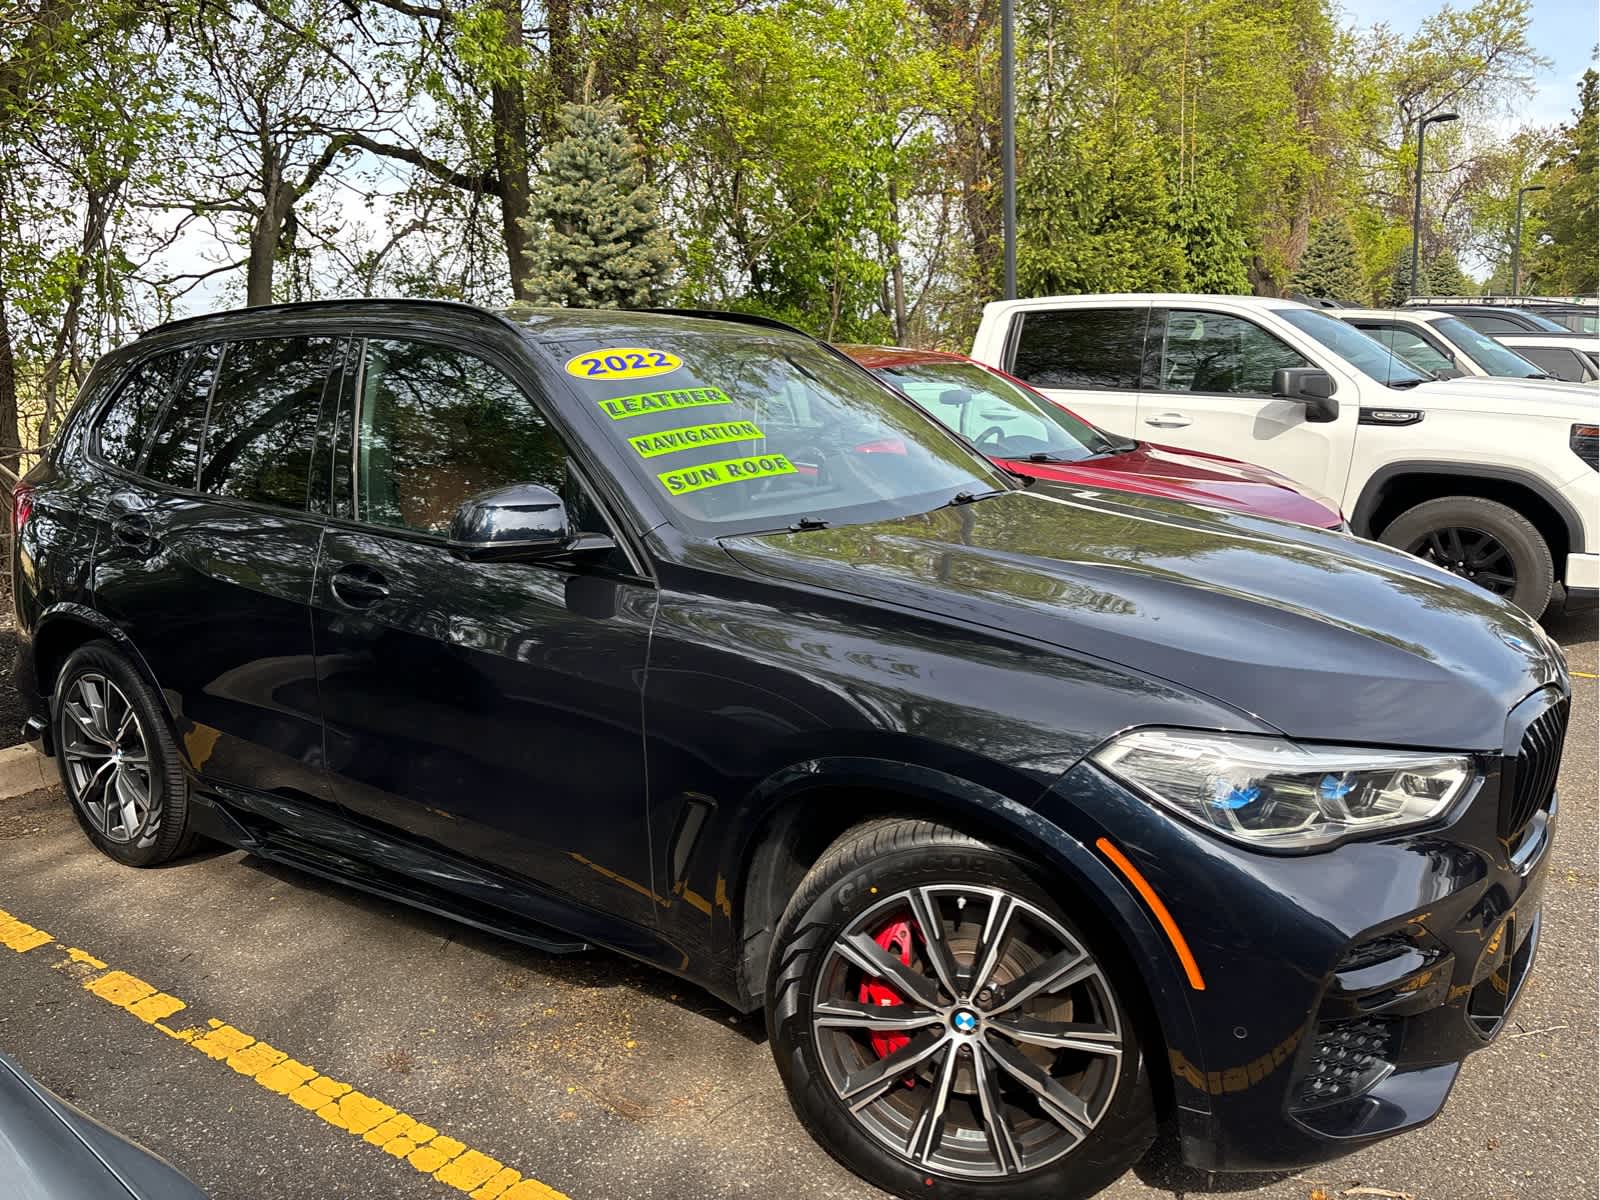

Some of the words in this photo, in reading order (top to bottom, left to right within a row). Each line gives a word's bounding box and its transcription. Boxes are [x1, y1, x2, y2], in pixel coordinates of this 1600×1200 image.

[581, 352, 673, 376] 2022
[605, 389, 722, 417] LEATHER
[635, 423, 756, 453] NAVIGATION
[666, 468, 721, 492] SUN
[726, 457, 789, 478] ROOF
